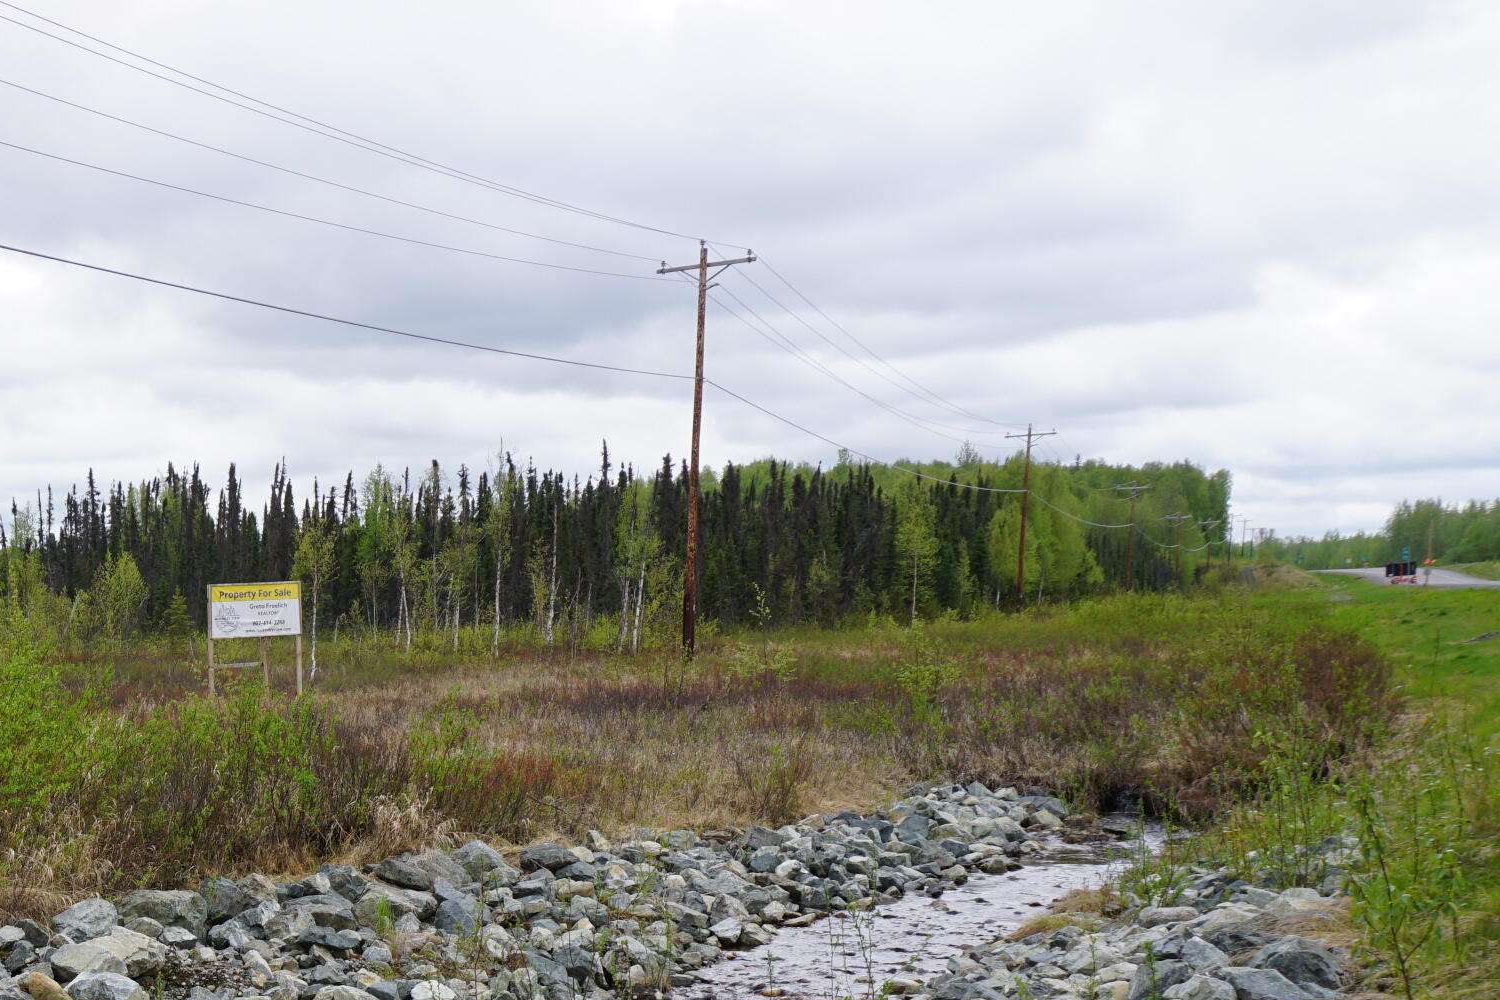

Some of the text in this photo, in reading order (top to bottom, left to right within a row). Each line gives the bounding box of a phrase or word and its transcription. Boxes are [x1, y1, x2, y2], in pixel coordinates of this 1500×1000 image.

[219, 588, 291, 600] Property For Sale
